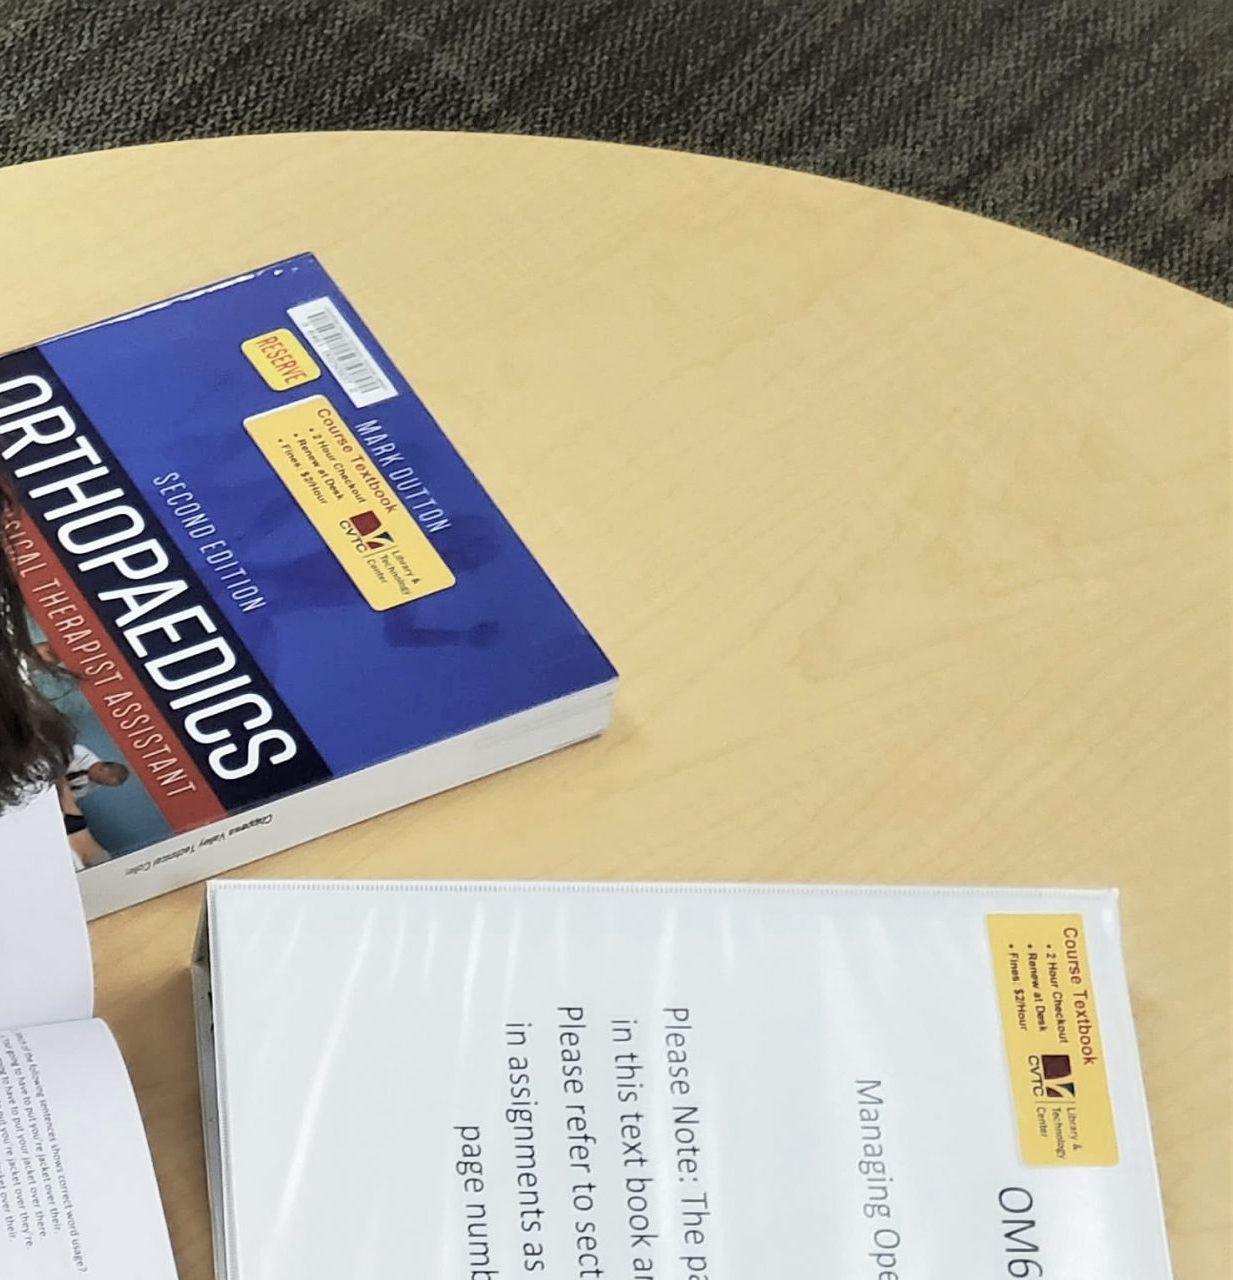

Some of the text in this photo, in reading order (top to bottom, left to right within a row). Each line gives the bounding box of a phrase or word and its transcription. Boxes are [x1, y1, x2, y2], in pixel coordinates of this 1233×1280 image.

[255, 334, 307, 386] RESERVE
[280, 443, 328, 504] Fines: $2/Hour
[295, 437, 344, 501] Renew at Desk
[316, 407, 353, 453] Course
[349, 453, 398, 513] Textbook
[316, 439, 337, 461] Hour
[332, 462, 367, 504] Checkout
[354, 418, 452, 532] MARK DUTTON
[152, 471, 267, 612] SECOND EDITION
[338, 518, 368, 553] CVTC
[365, 558, 388, 583] Center
[378, 553, 411, 595] Technology
[390, 549, 421, 585] Library &
[3, 507, 198, 799] SICAL THERAPIST ASSISTANT
[1008, 951, 1028, 1031] Fines: $2/Hour
[1027, 952, 1048, 1032] Renew at Desk
[1046, 961, 1059, 988] Hour
[1062, 926, 1098, 1065] Course Textbook
[504, 1022, 532, 1045] in
[610, 1019, 638, 1042] in
[1051, 990, 1069, 1043] Checkout
[556, 1006, 587, 1094] Please
[613, 1051, 644, 1102] this
[662, 1007, 693, 1095] Please
[1027, 1054, 1044, 1097] CVTC
[28, 1062, 45, 1098] following
[38, 1098, 56, 1142] sentences
[504, 1056, 545, 1232] assignments
[565, 1104, 597, 1173] refer
[619, 1111, 648, 1167] text
[671, 1105, 700, 1182] Note:
[1035, 1105, 1048, 1138] Center
[1051, 1106, 1066, 1159] Technology
[1065, 1106, 1082, 1151] Library &
[49, 1143, 64, 1173] shows
[452, 1125, 484, 1193] page
[854, 1079, 894, 1218] Managing
[56, 1174, 73, 1209] correct
[571, 1181, 597, 1211] to
[625, 1177, 659, 1248] book
[680, 1191, 710, 1244] The
[65, 1209, 80, 1237] word
[998, 1186, 1044, 1279] OM6
[70, 1237, 88, 1272] usage?
[522, 1241, 545, 1271] as
